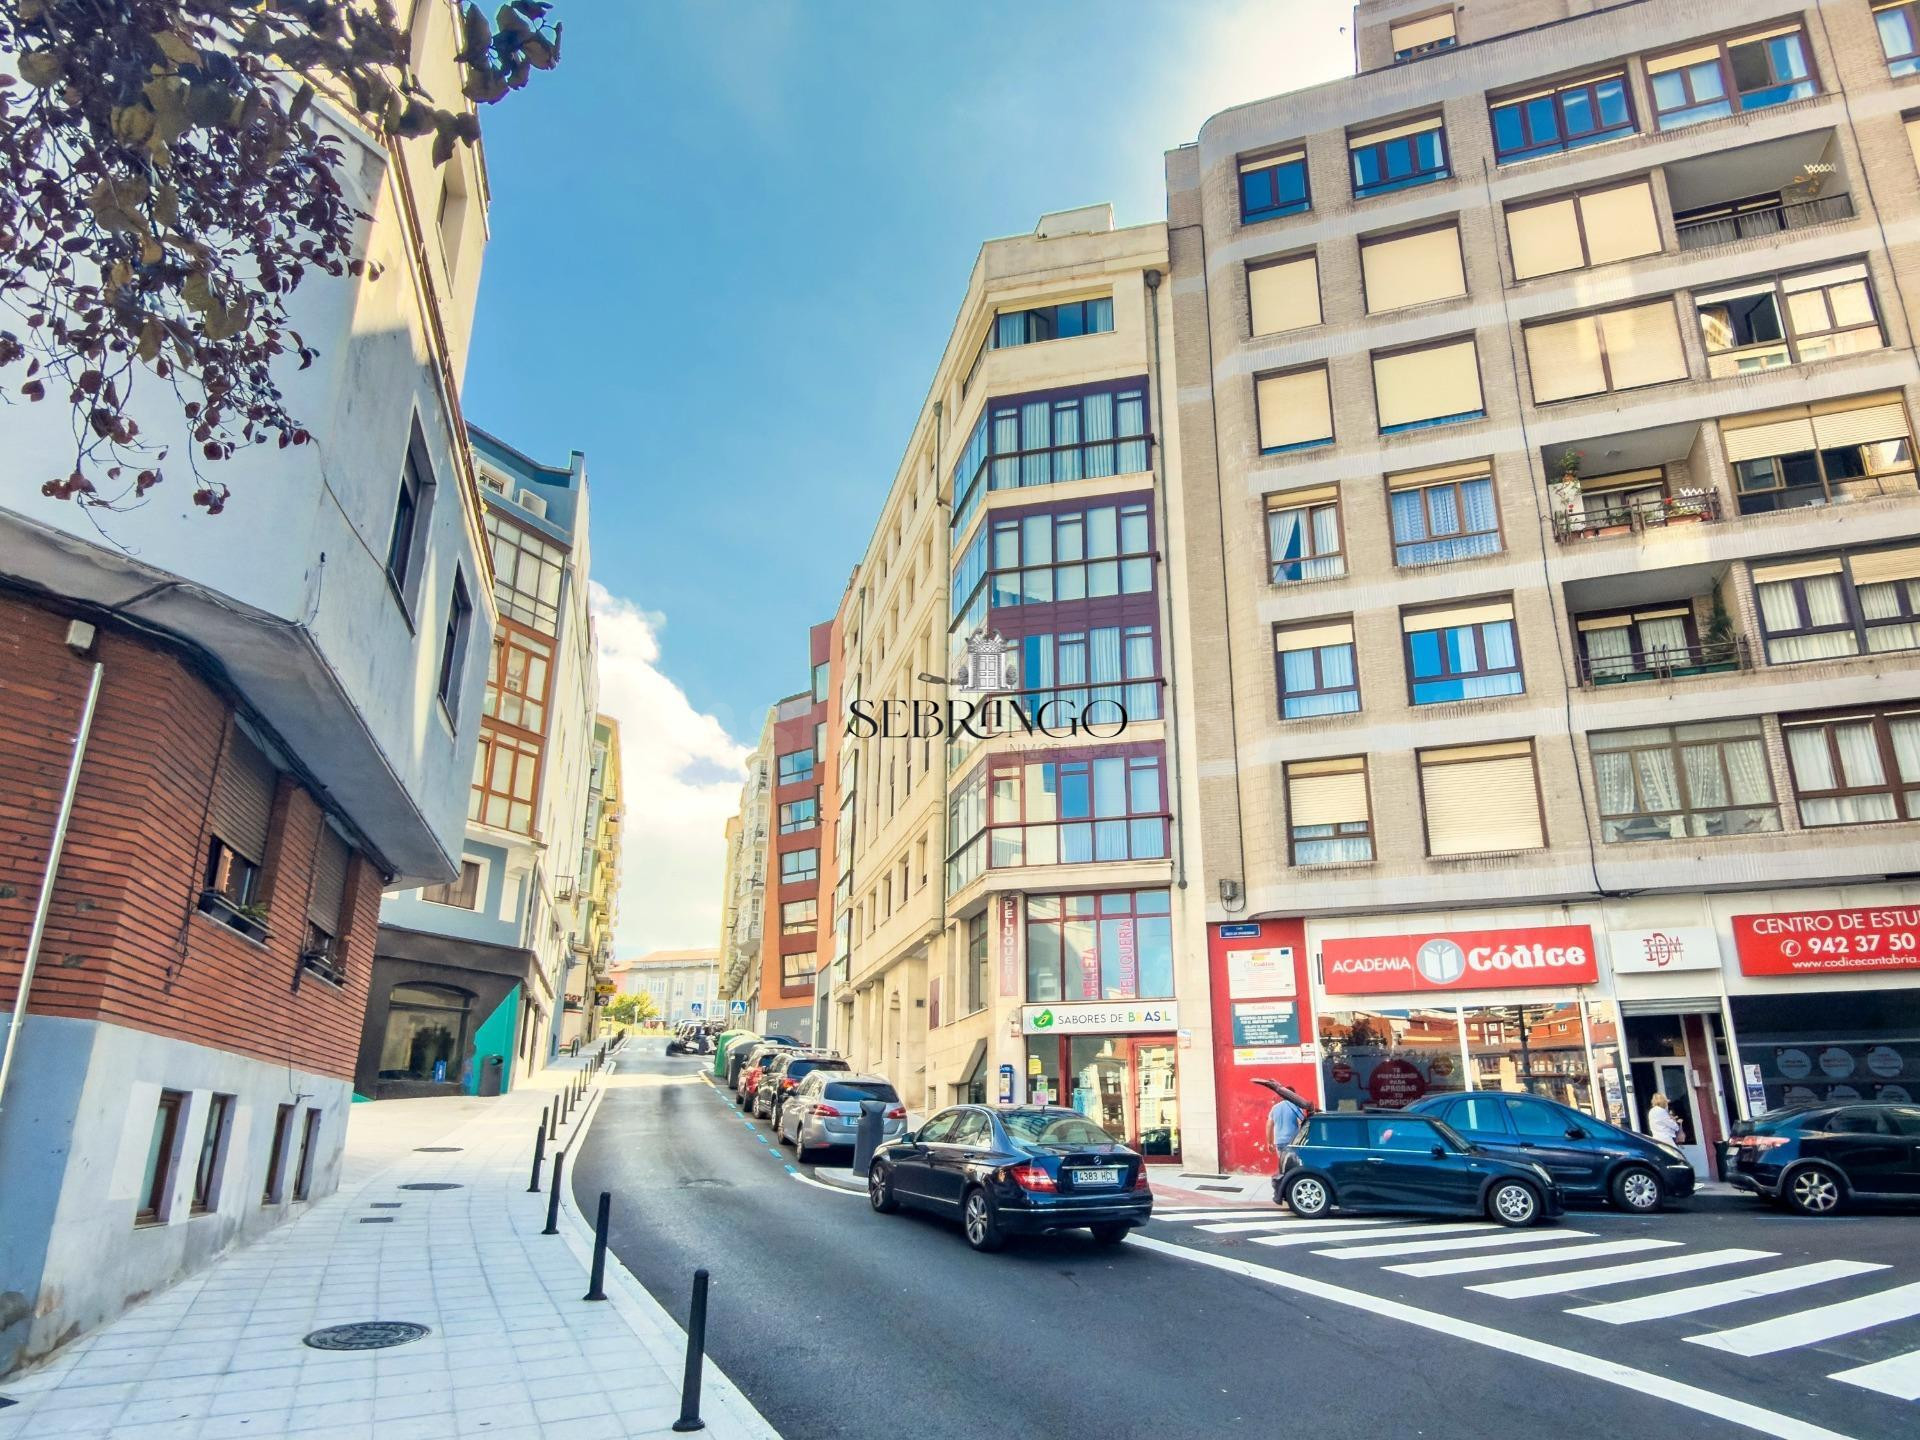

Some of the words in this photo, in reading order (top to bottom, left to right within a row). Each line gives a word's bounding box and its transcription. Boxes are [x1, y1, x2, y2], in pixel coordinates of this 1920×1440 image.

[1753, 914, 1834, 935] CENTRO
[1839, 913, 1864, 929] DE
[1871, 909, 1920, 928] ESTU
[1807, 937, 1850, 954] 942
[1855, 935, 1880, 952] 37
[1889, 933, 1916, 951] 50
[1332, 957, 1411, 973] ACADEMIA
[1468, 943, 1586, 971] Códice
[1058, 1013, 1107, 1025] SABORES
[1110, 1013, 1125, 1023] DE
